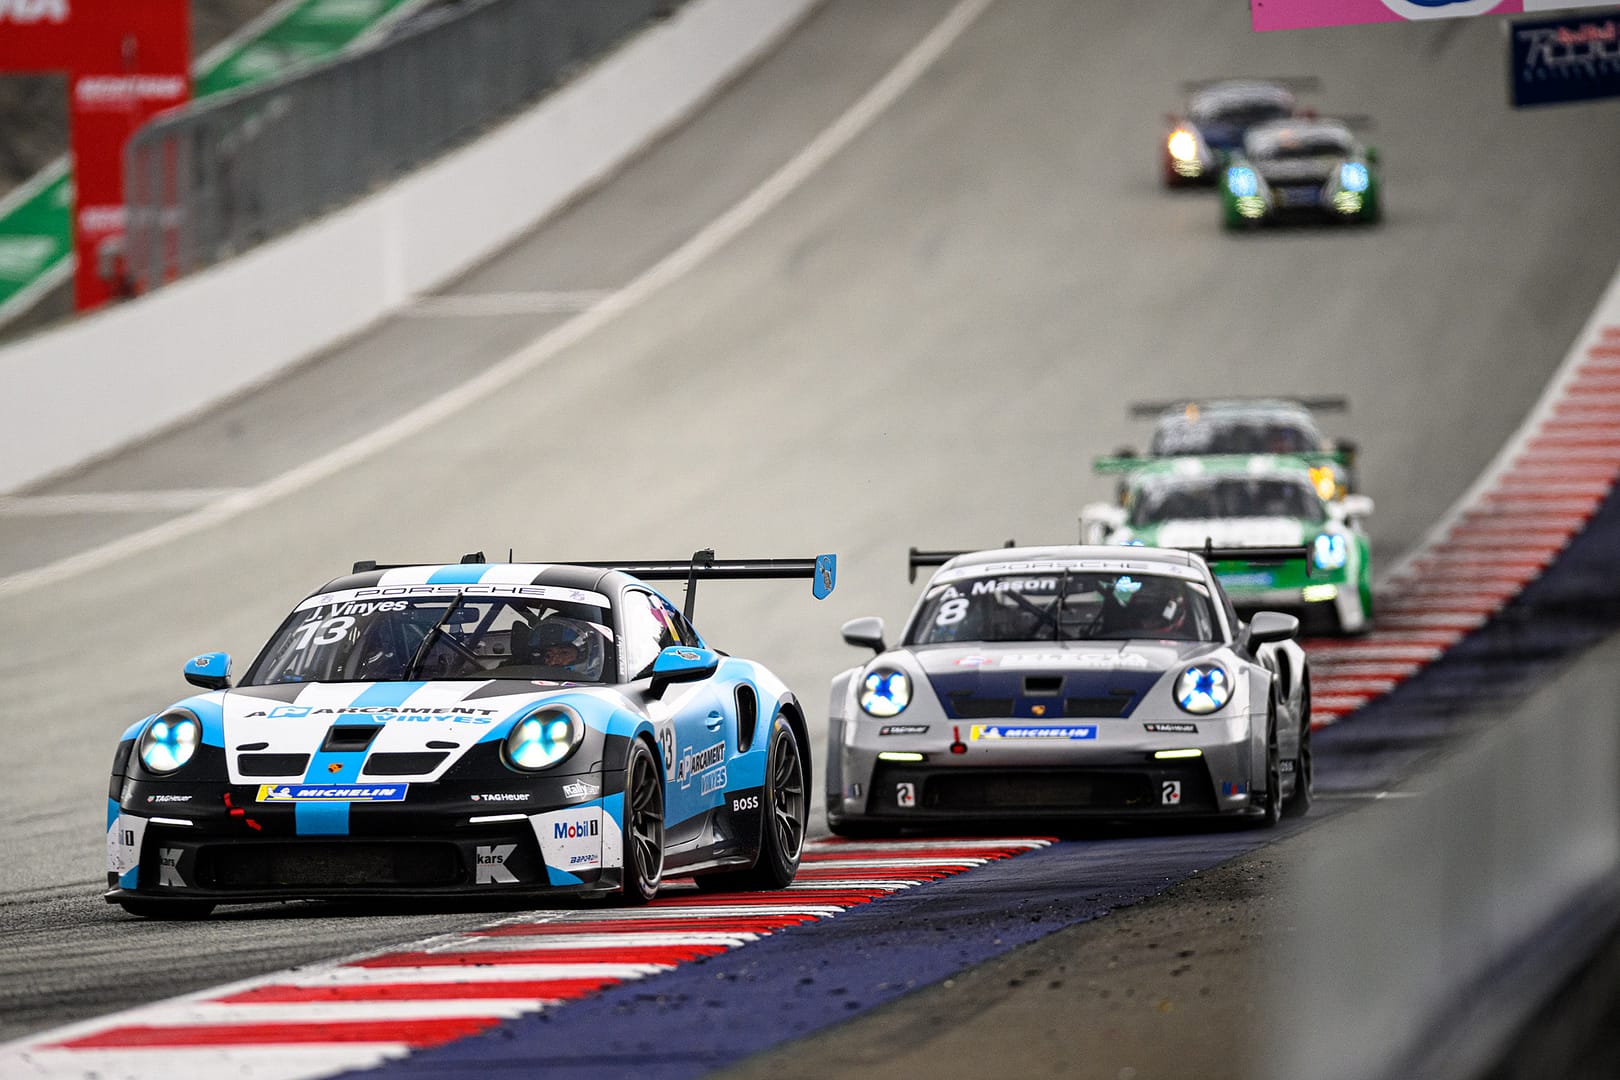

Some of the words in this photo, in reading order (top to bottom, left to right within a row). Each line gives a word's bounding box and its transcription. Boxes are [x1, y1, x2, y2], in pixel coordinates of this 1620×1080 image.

[985, 561, 1148, 571] PORSCHE
[355, 585, 546, 598] PORSCHE
[940, 585, 964, 601] A.
[971, 578, 1056, 595] Mason
[305, 606, 323, 623] J.
[331, 600, 408, 617] Vinyes
[936, 598, 970, 625] 8
[292, 616, 355, 650] 13
[375, 713, 493, 725] VINYES
[1005, 728, 1090, 738] MICHELIN
[297, 788, 396, 798] MICHELIN
[733, 796, 759, 811] BOSS
[554, 819, 588, 839] Mobil
[477, 853, 504, 864] kars
